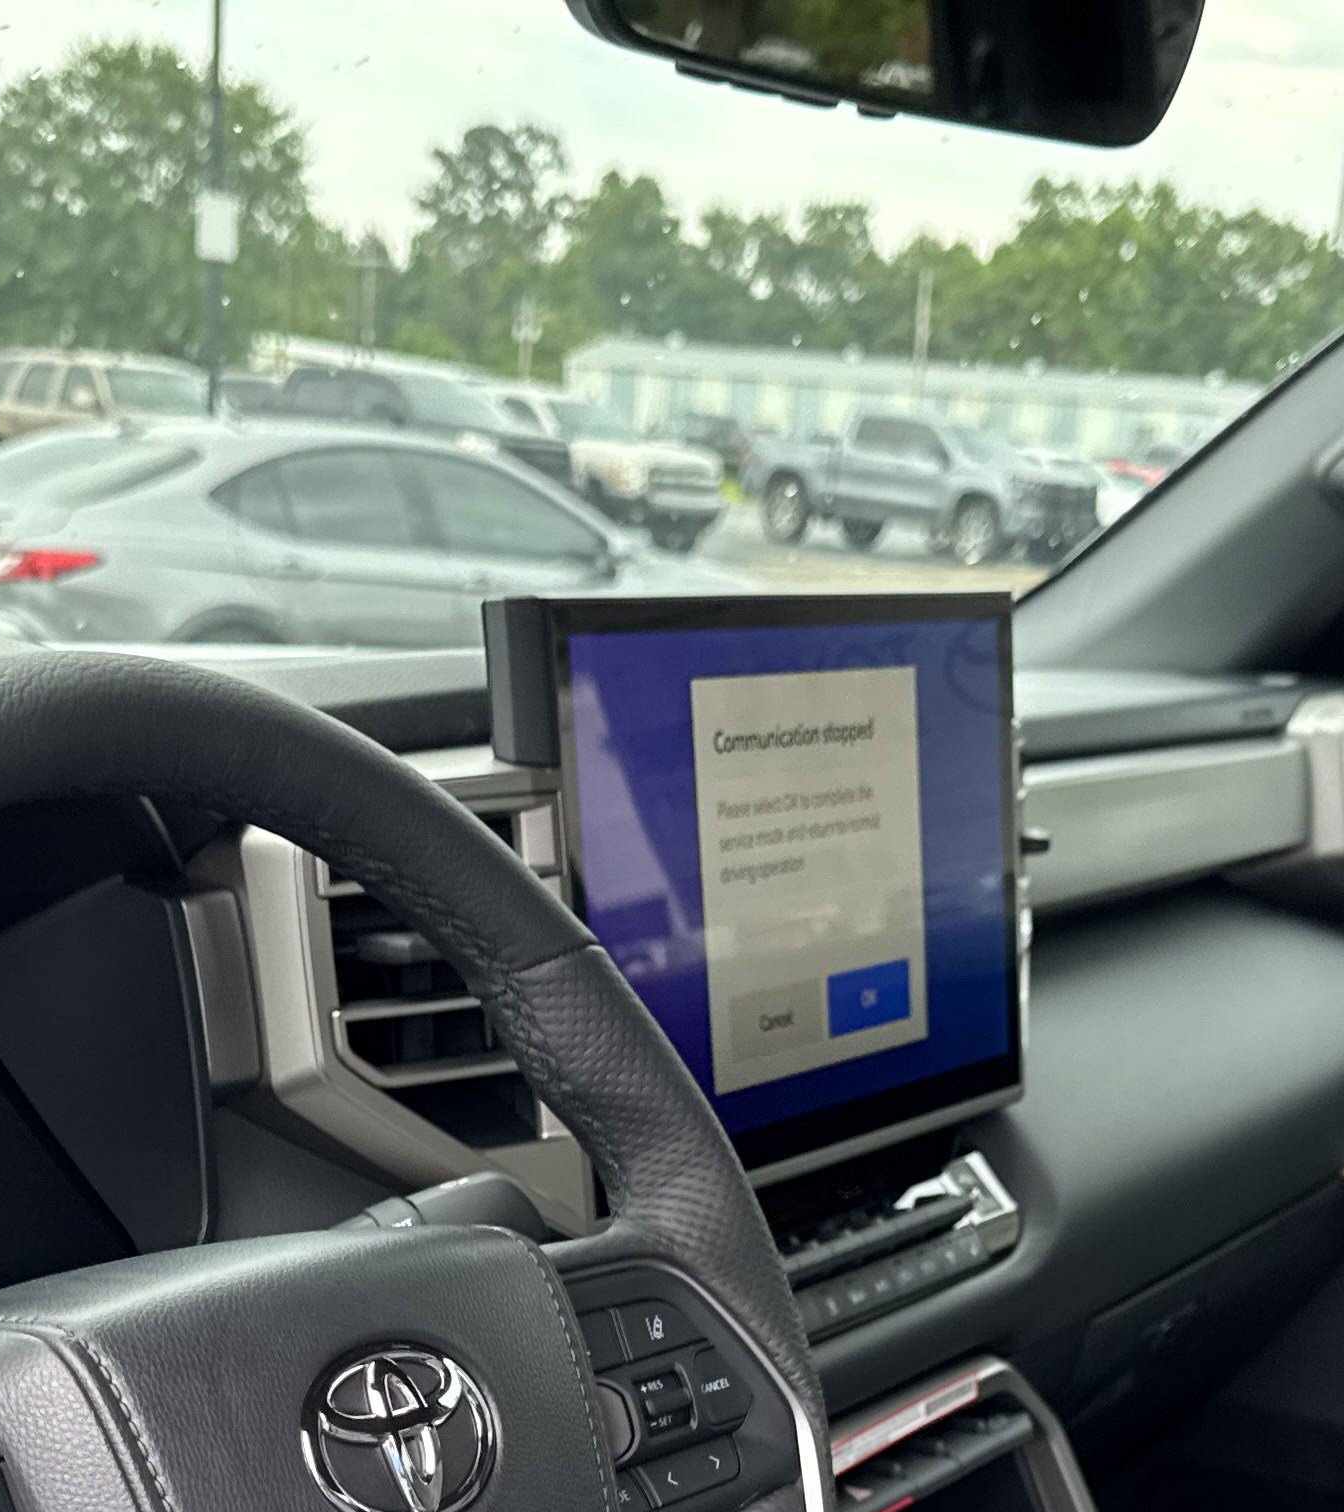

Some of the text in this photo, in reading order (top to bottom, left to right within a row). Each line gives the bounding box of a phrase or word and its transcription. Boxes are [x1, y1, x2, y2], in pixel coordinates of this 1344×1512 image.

[713, 716, 875, 754] Communication stopped
[716, 800, 751, 820] Please
[752, 796, 781, 814] select
[811, 787, 855, 808] complete
[718, 834, 754, 853] service
[755, 827, 784, 845] mode
[758, 1009, 794, 1032] Cancel
[700, 1377, 731, 1393] CANCEL
